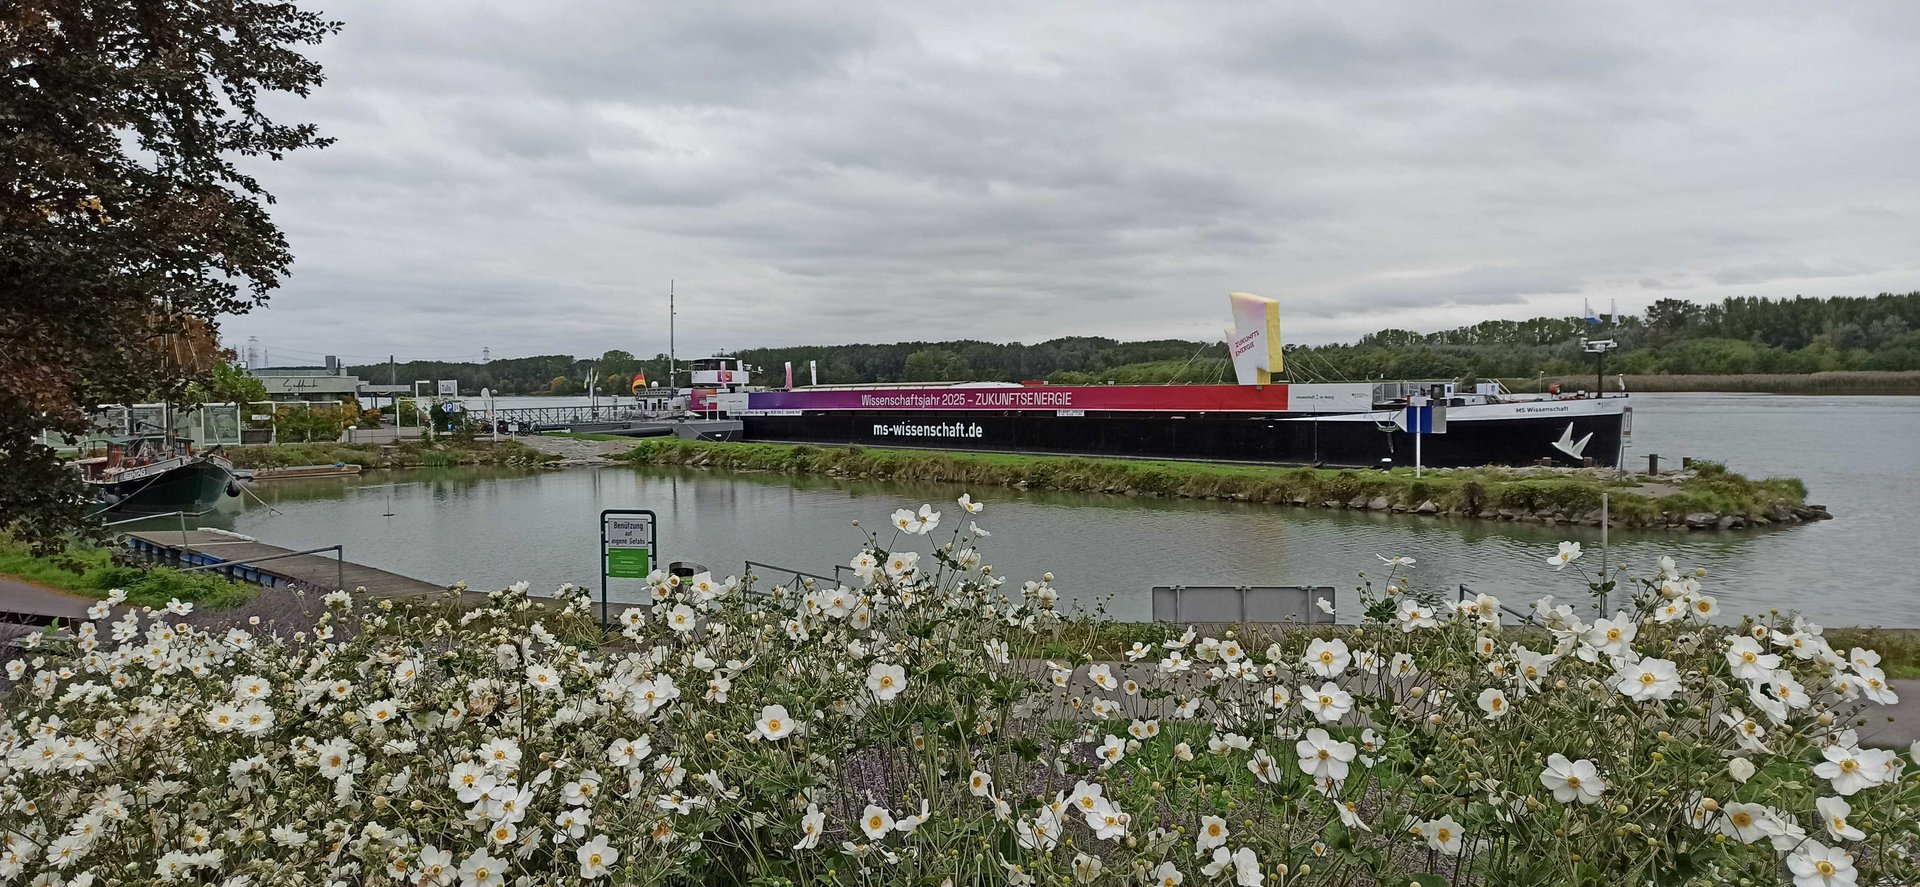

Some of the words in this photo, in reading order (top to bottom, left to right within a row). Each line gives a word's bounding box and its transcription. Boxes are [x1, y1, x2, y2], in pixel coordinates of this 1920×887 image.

[861, 394, 940, 408] Wissenschaftsjahr
[942, 393, 965, 406] 2025
[975, 392, 1072, 405] ZUKUNFTSENERGIE
[447, 403, 452, 412] P
[873, 421, 982, 437] ms-wissenschaft.de
[614, 521, 643, 531] Benützung
